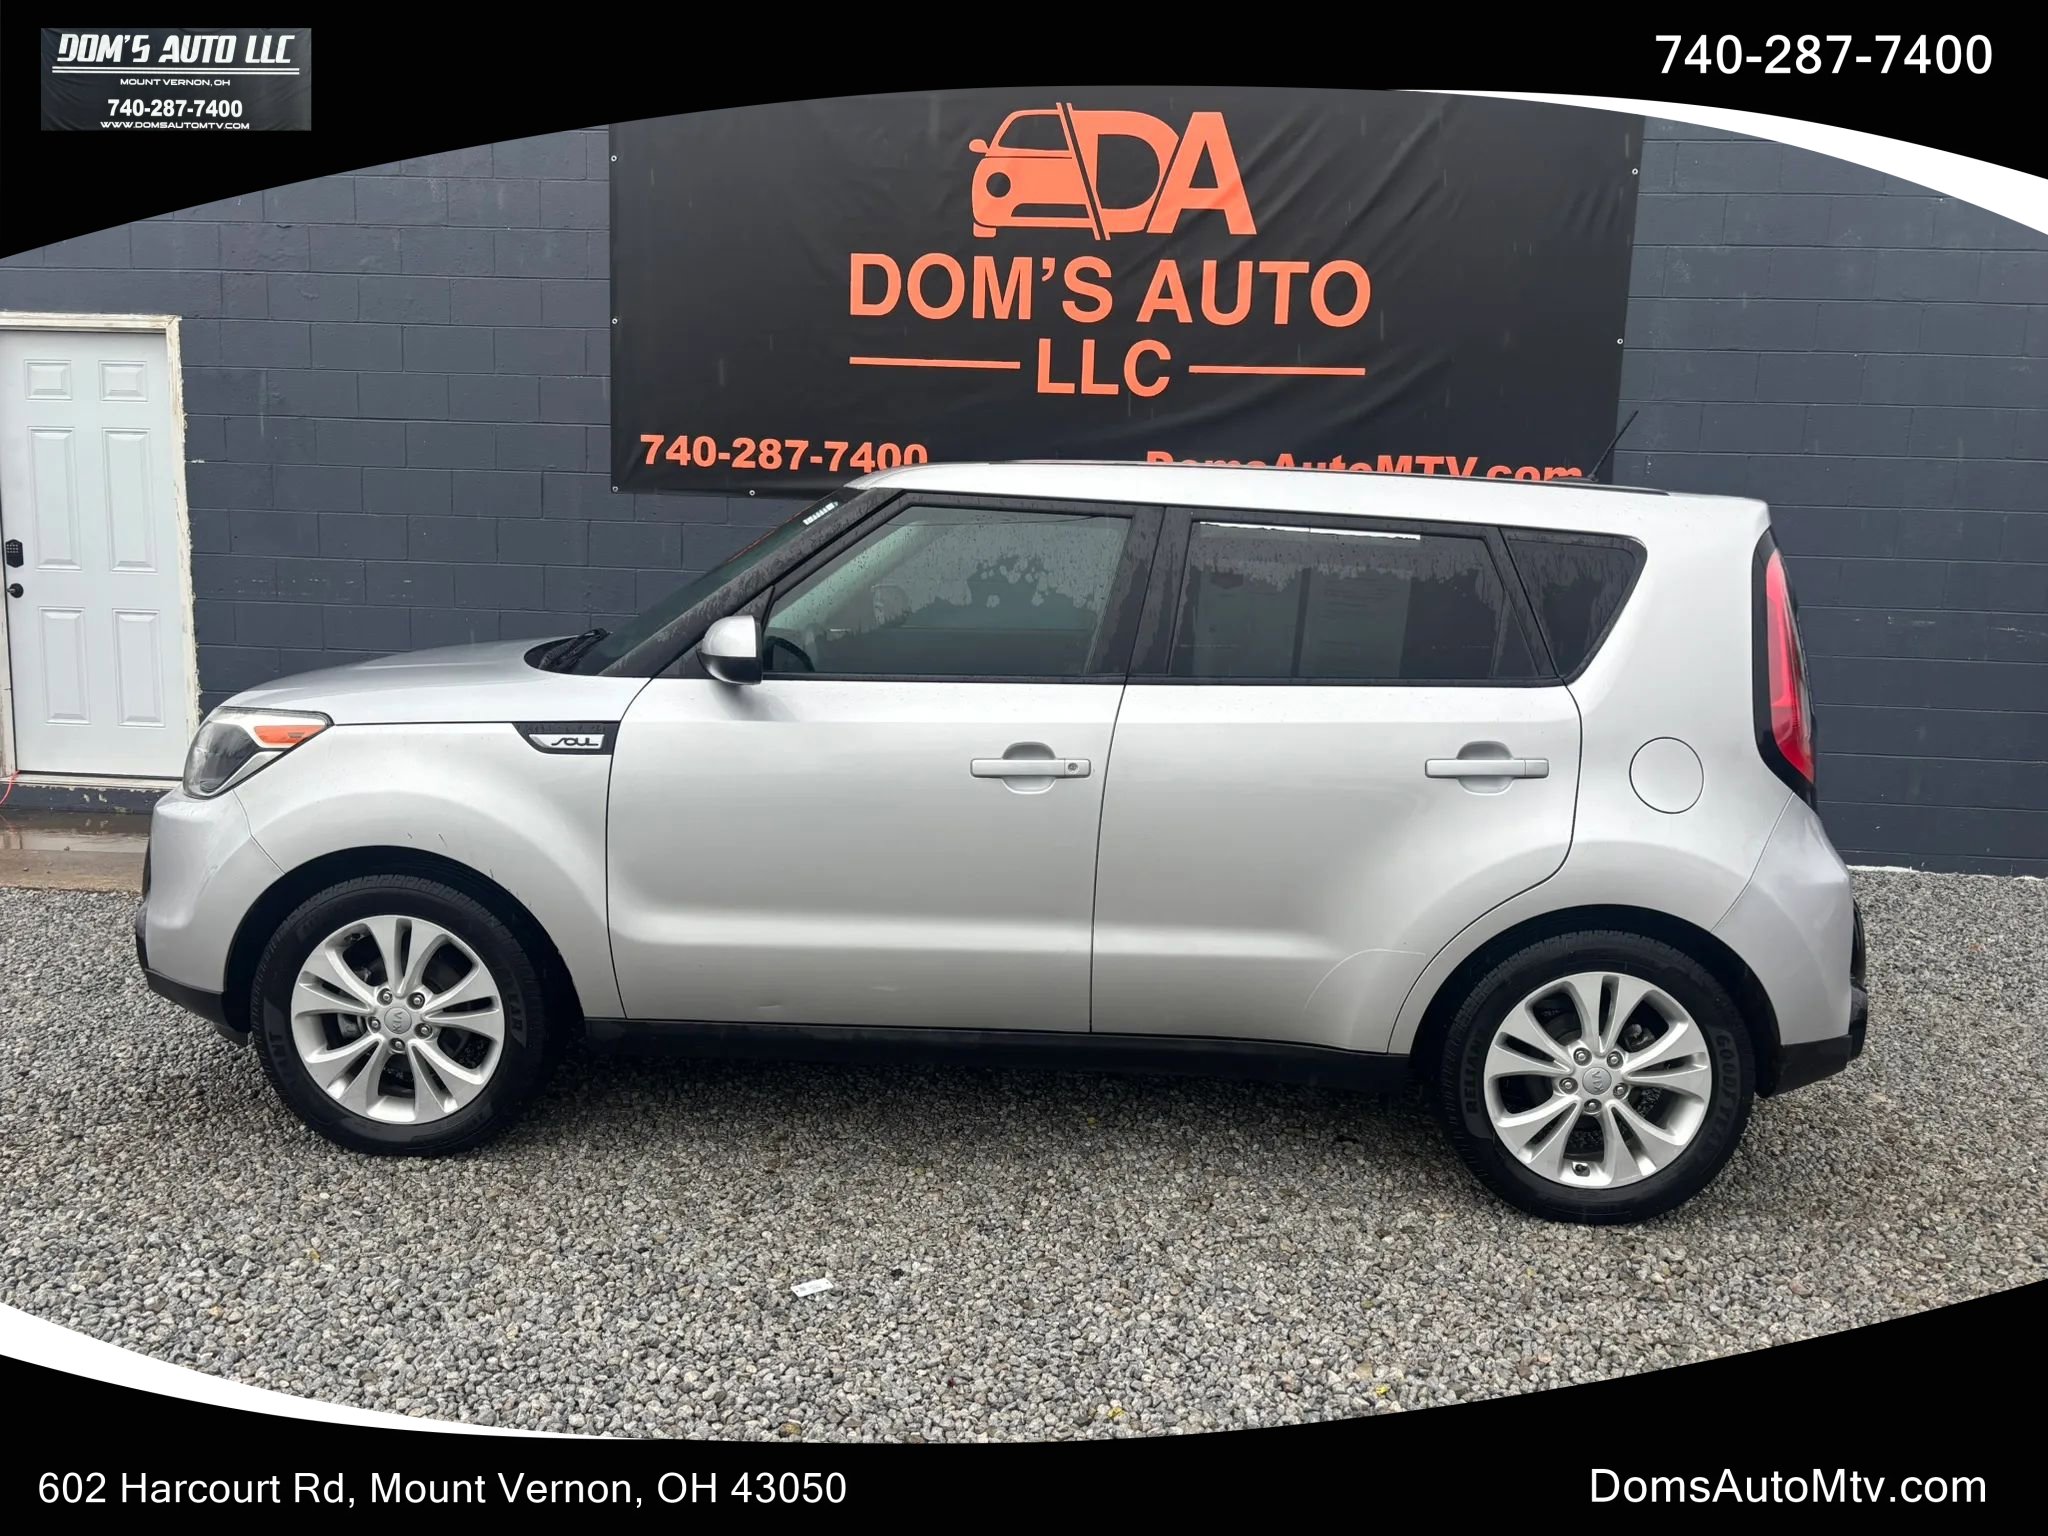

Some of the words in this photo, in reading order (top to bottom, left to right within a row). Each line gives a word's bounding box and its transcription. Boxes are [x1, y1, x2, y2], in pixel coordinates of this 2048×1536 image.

[849, 252, 1113, 324] DOM'S
[1137, 259, 1371, 328] AUTO
[1037, 338, 1172, 398] LLC
[640, 434, 928, 474] 740-287-7400
[551, 737, 598, 746] SOUL
